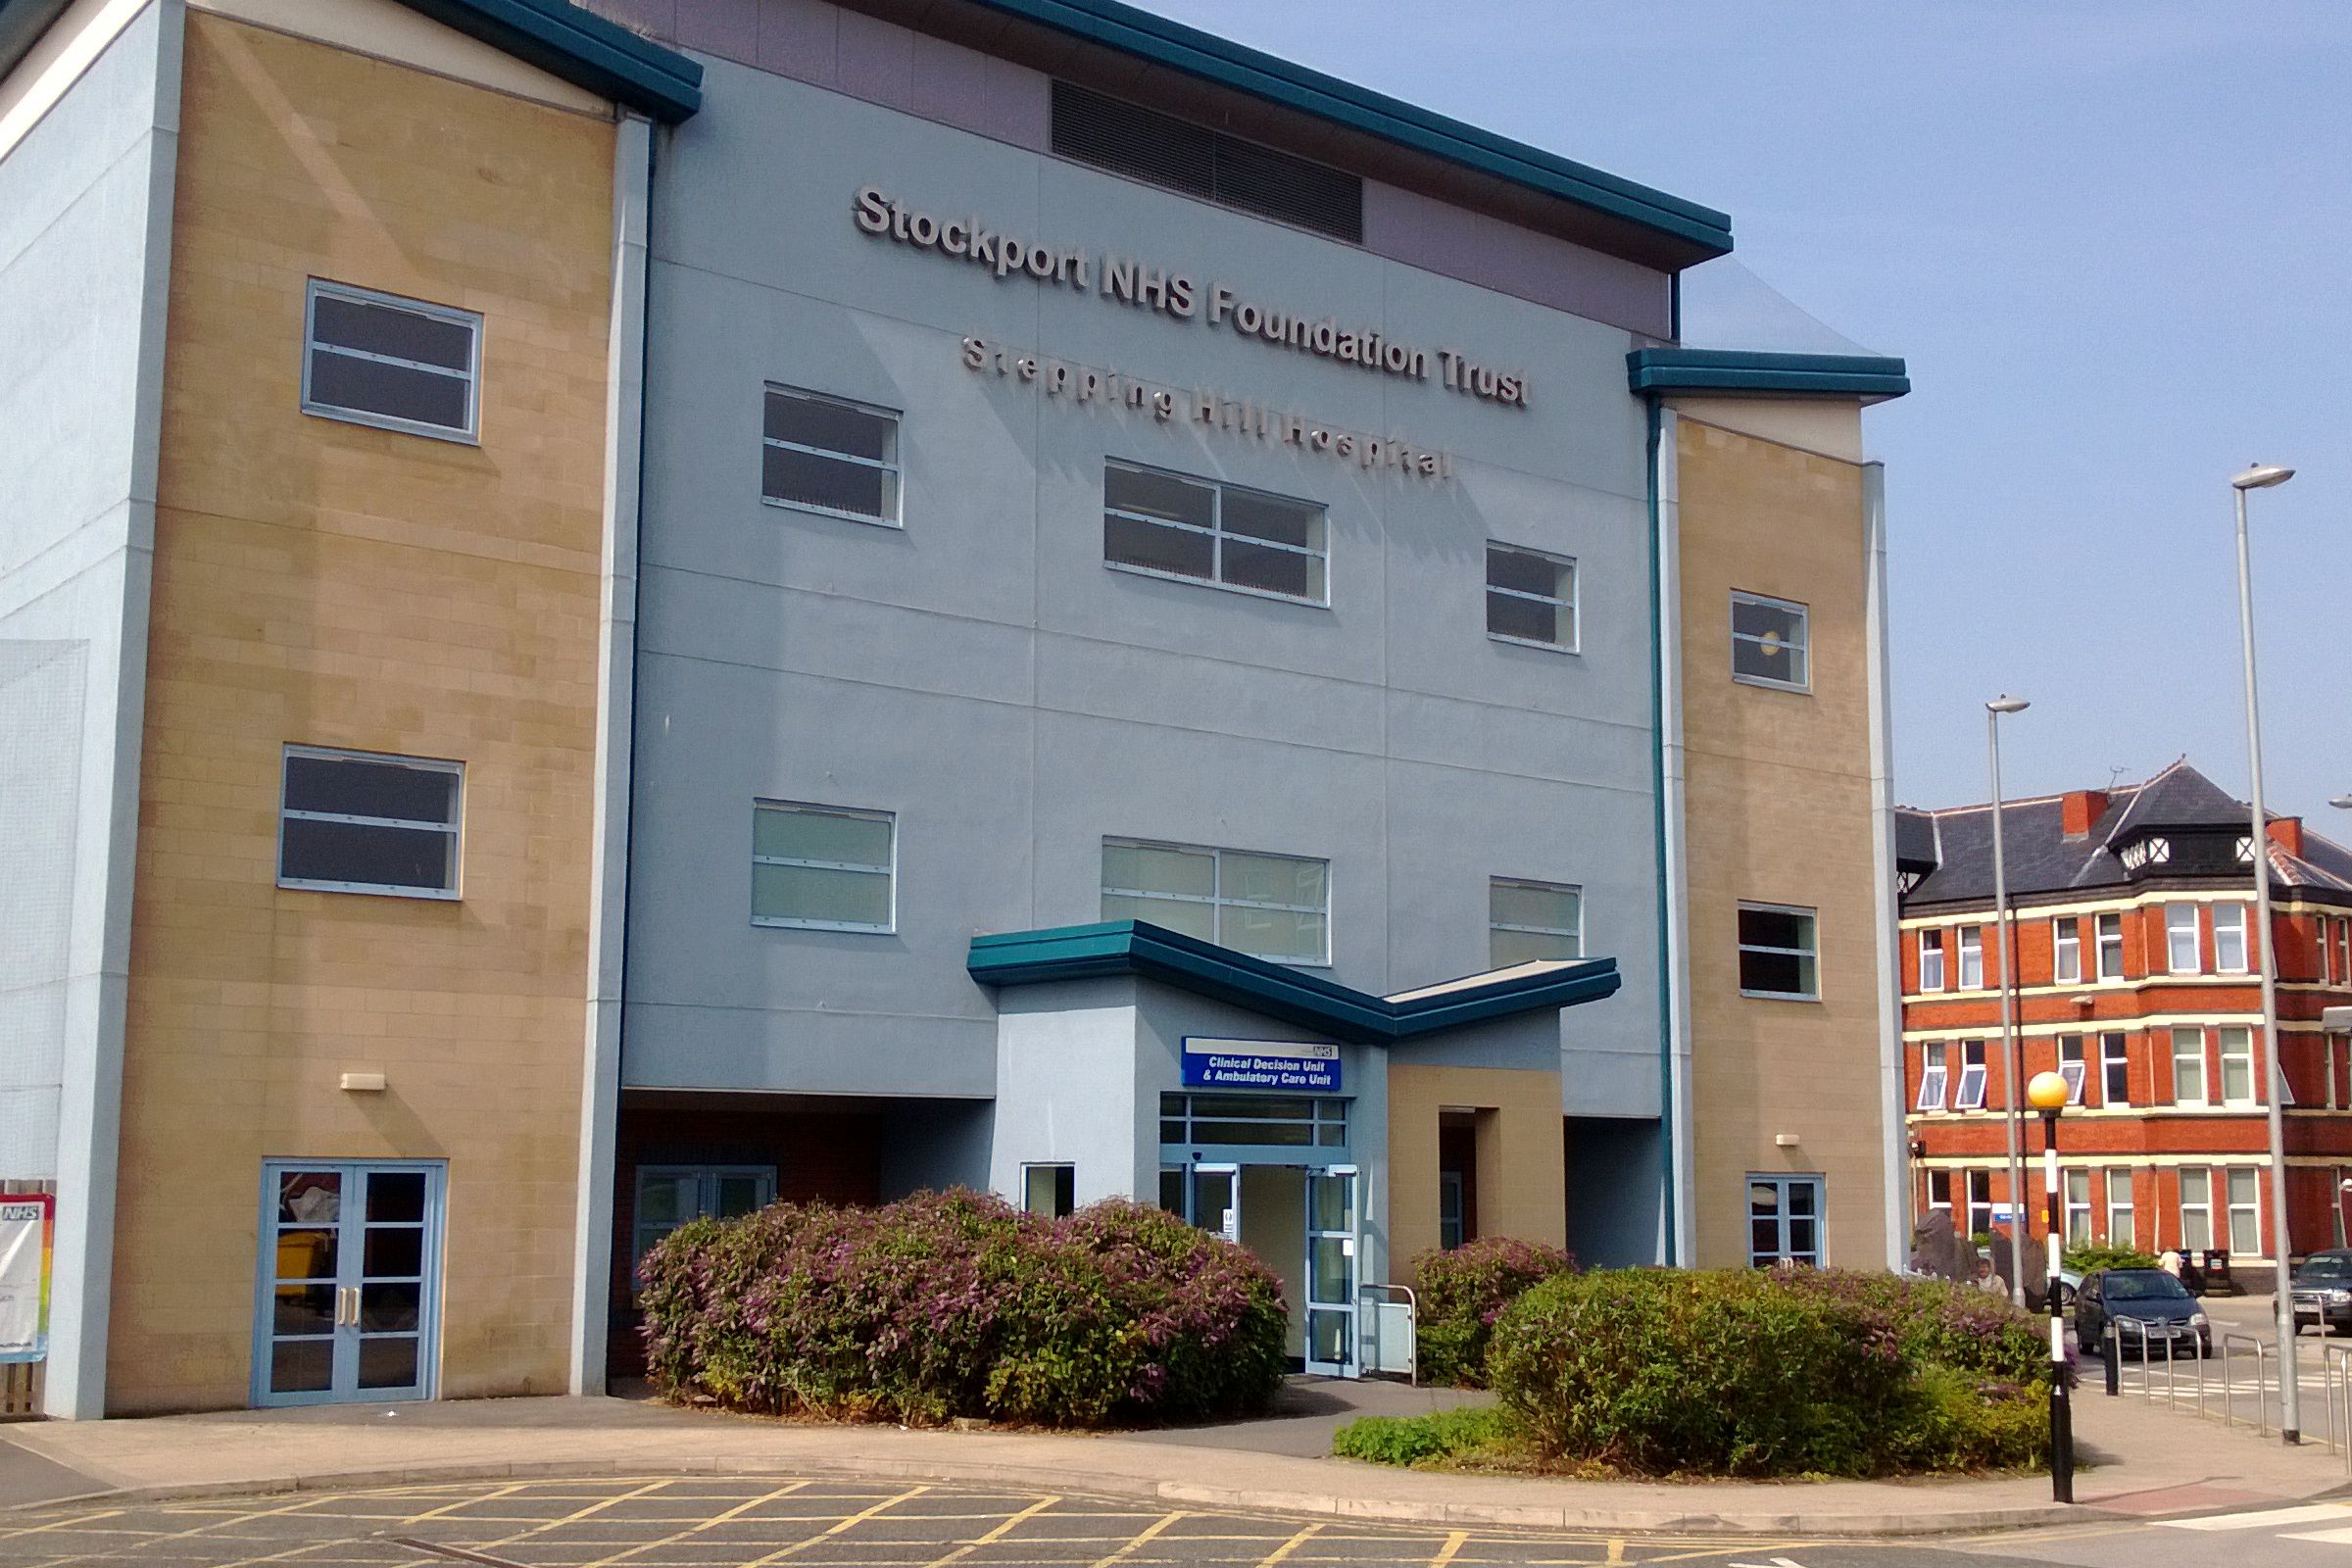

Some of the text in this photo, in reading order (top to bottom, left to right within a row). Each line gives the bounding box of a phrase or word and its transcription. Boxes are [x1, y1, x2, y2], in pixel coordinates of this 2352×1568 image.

[854, 185, 1531, 405] Stockport NHS Foundation Trust
[962, 334, 1454, 480] Stepping Hill Hospital
[1208, 1056, 1325, 1072] Clinical Decision Unit
[1203, 1069, 1331, 1085] & Ambulatory Care Unit
[3, 1206, 38, 1220] NHS
